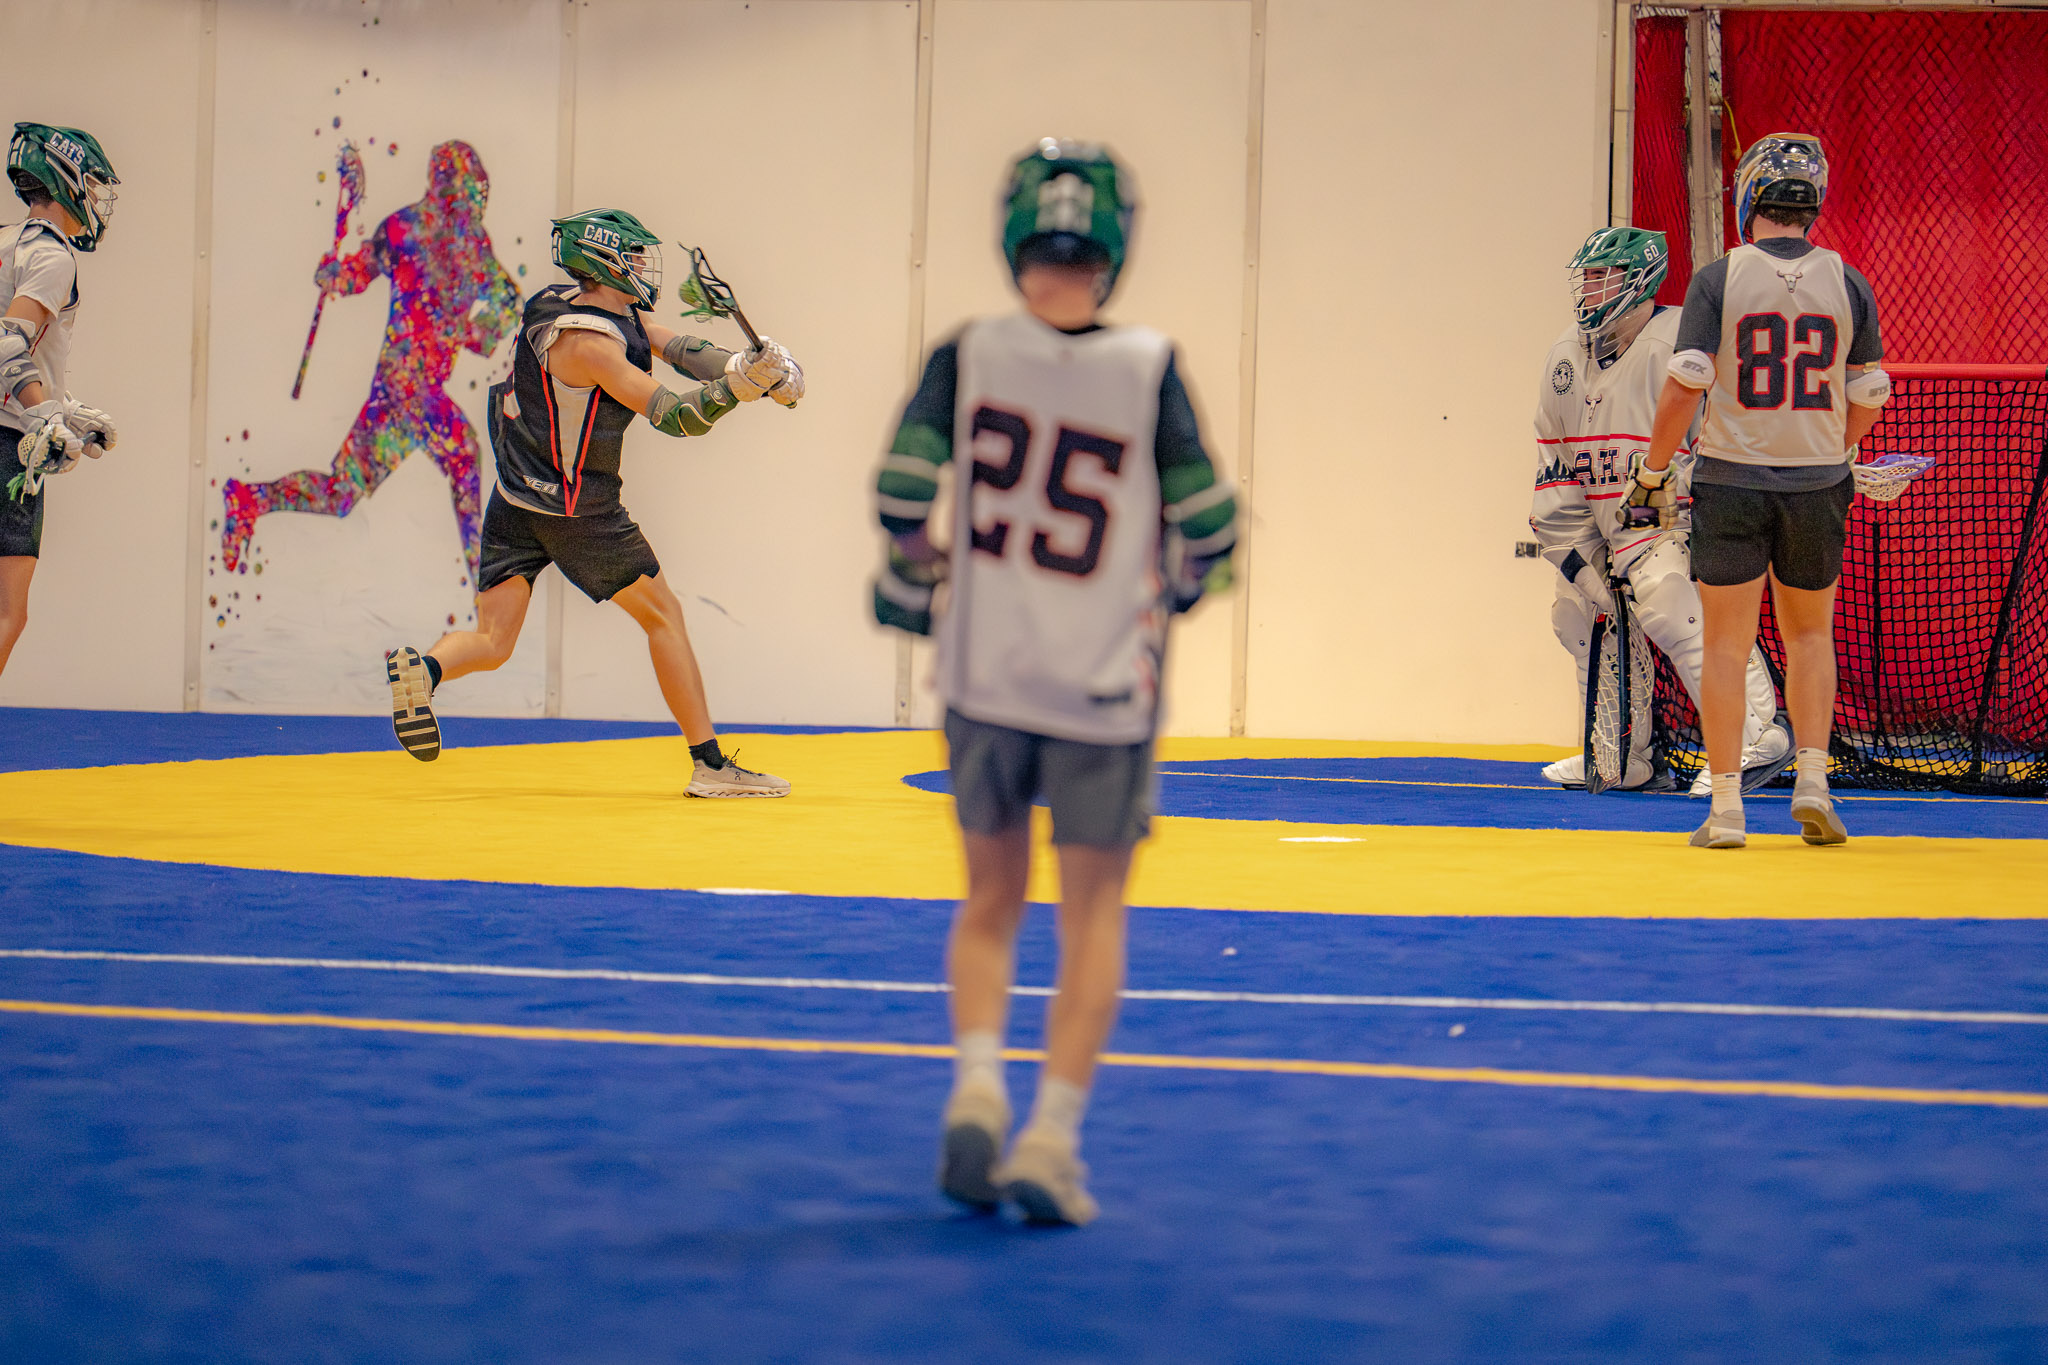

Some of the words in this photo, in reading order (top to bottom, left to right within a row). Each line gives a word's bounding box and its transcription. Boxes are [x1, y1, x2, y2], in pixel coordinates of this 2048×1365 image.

[50, 132, 85, 165] CATS
[584, 224, 621, 248] CATS
[1643, 244, 1660, 262] 60
[1736, 311, 1839, 412] 82
[970, 404, 1127, 577] 25
